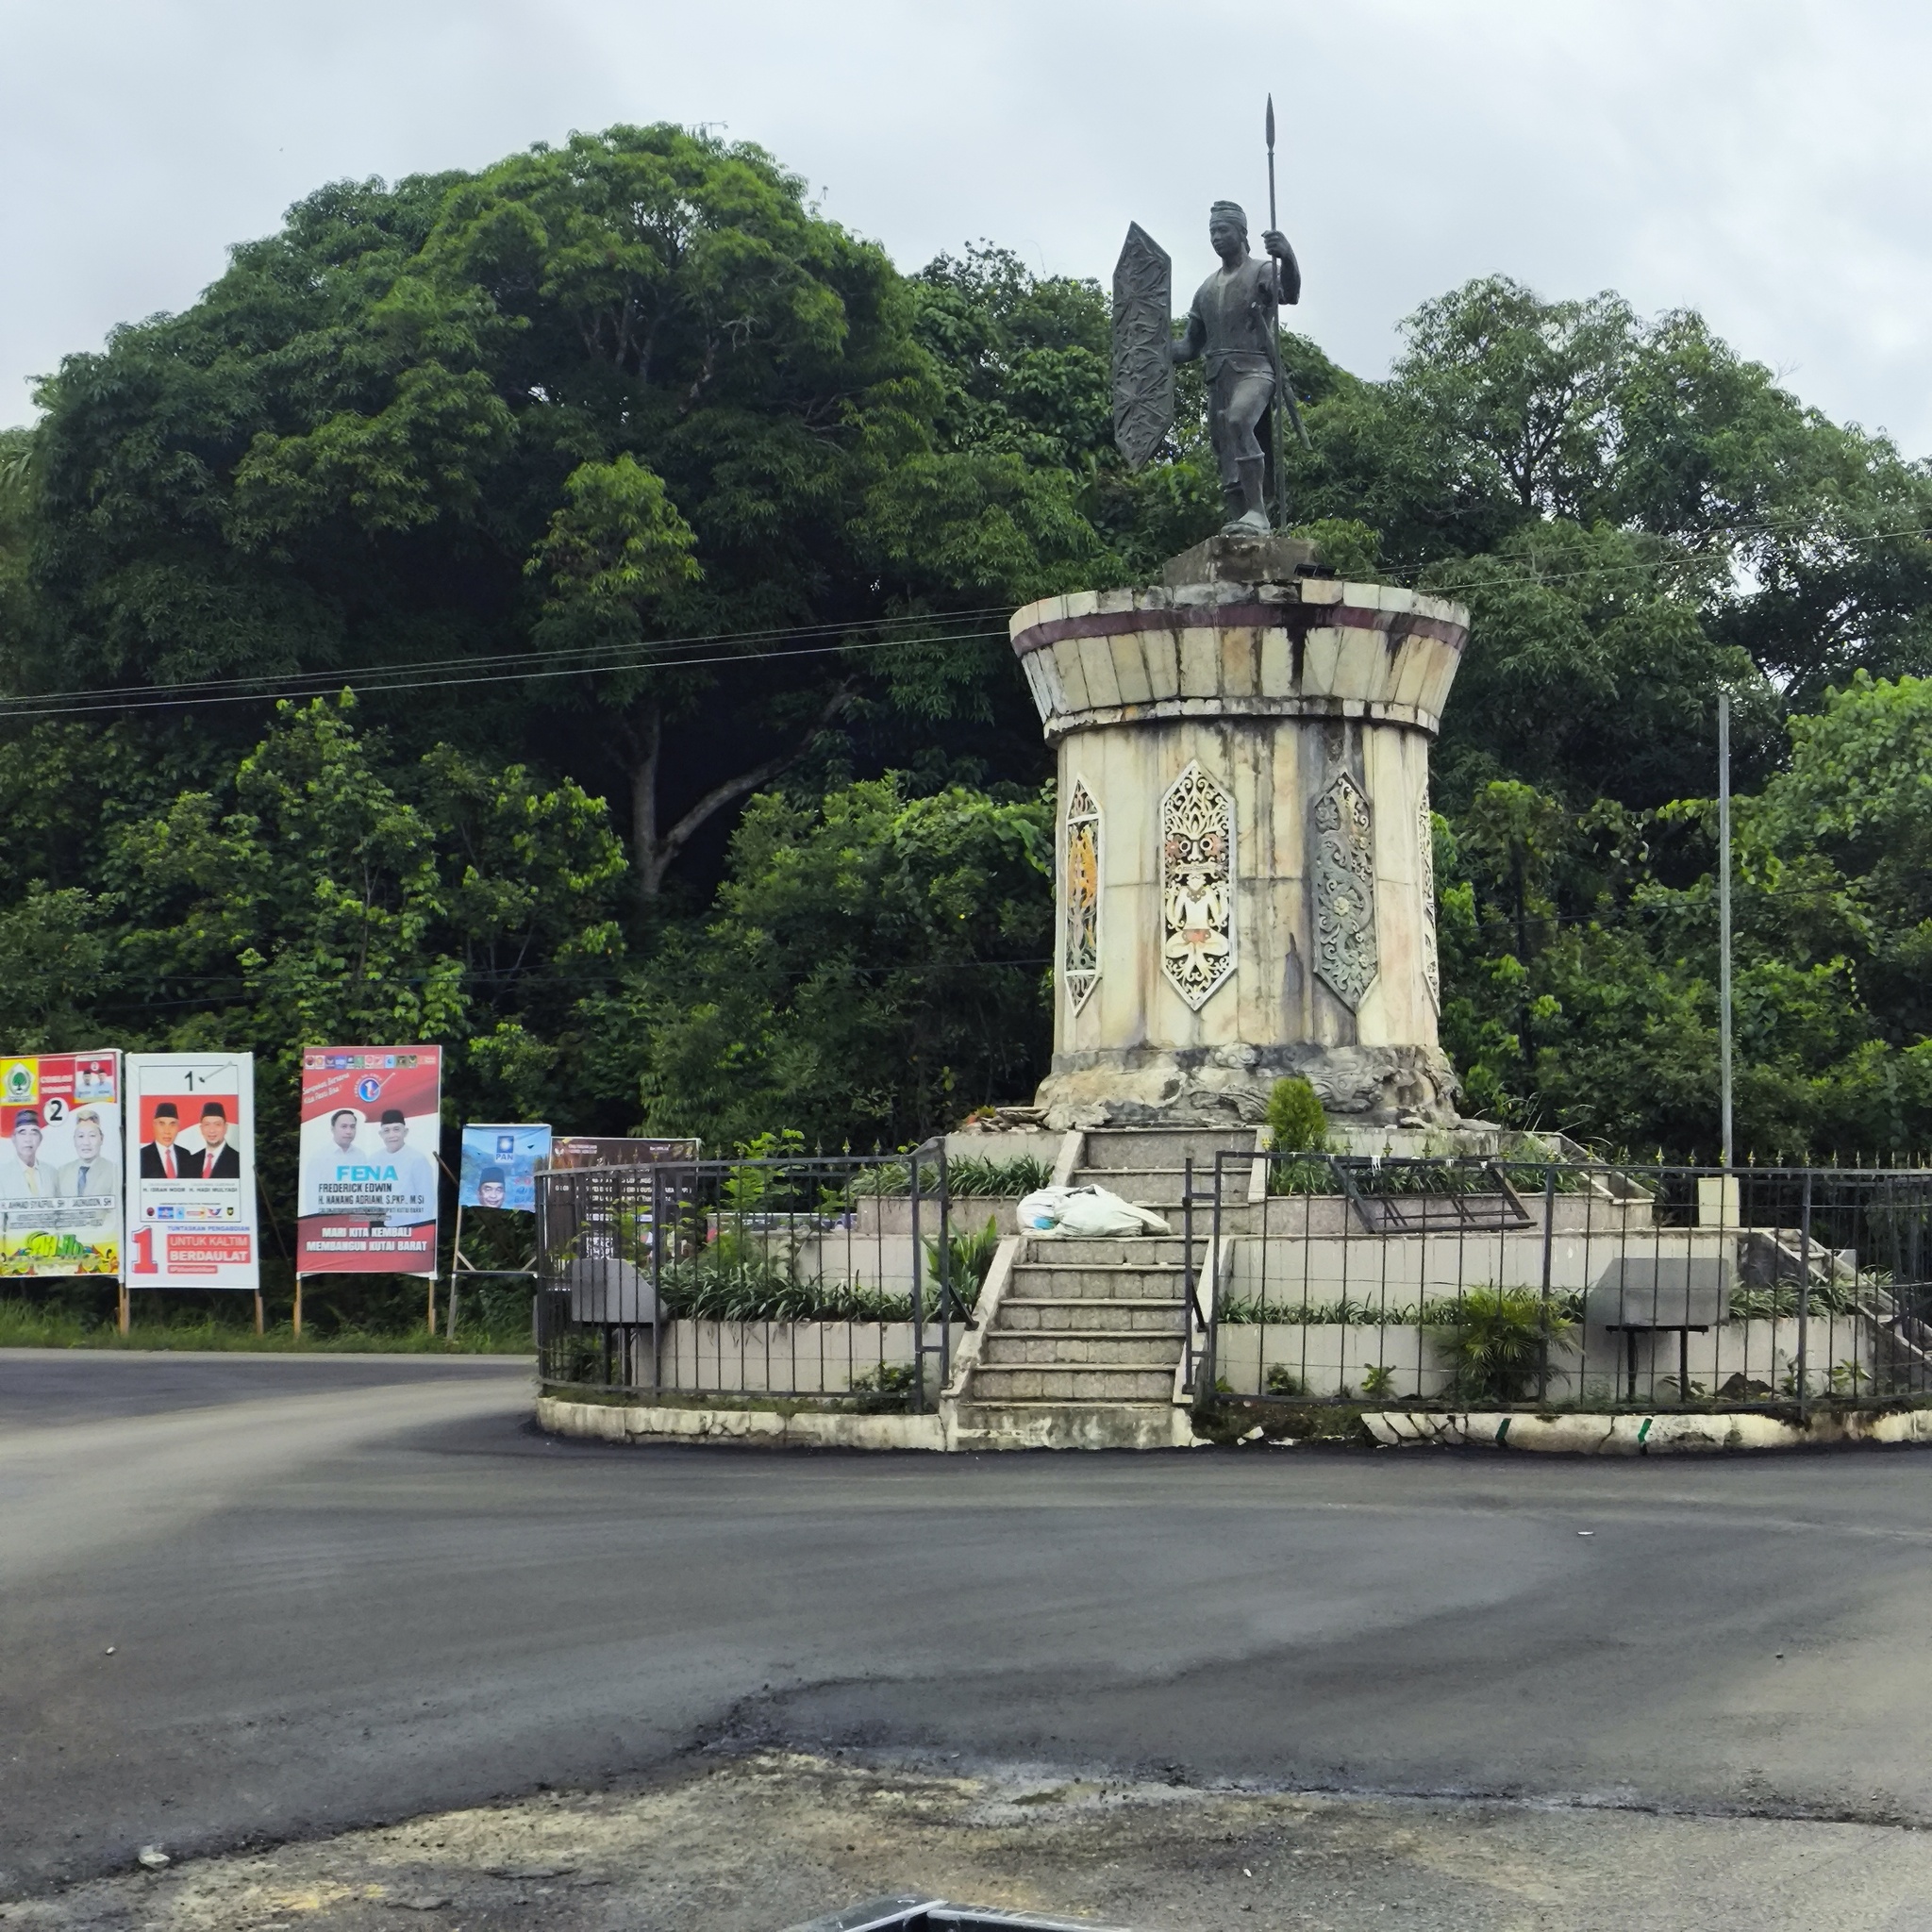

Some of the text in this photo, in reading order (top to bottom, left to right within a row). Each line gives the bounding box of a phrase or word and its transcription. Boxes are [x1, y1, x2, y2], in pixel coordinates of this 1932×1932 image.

[185, 1071, 192, 1091] 1
[364, 1081, 374, 1097] 1
[50, 1100, 62, 1121] 2
[336, 1165, 398, 1181] FENA
[318, 1183, 392, 1192] FREDERICK EDWIN
[103, 1197, 111, 1207] SH
[325, 1195, 354, 1205] NANANG
[322, 1227, 411, 1238] MARI KITA KEMBALI
[170, 1236, 248, 1246] UNTUK KALTIM
[307, 1241, 427, 1252] MEMBANGUN KUTAI BARAT
[131, 1225, 158, 1274] 1
[170, 1251, 248, 1261] BERDAULAT
